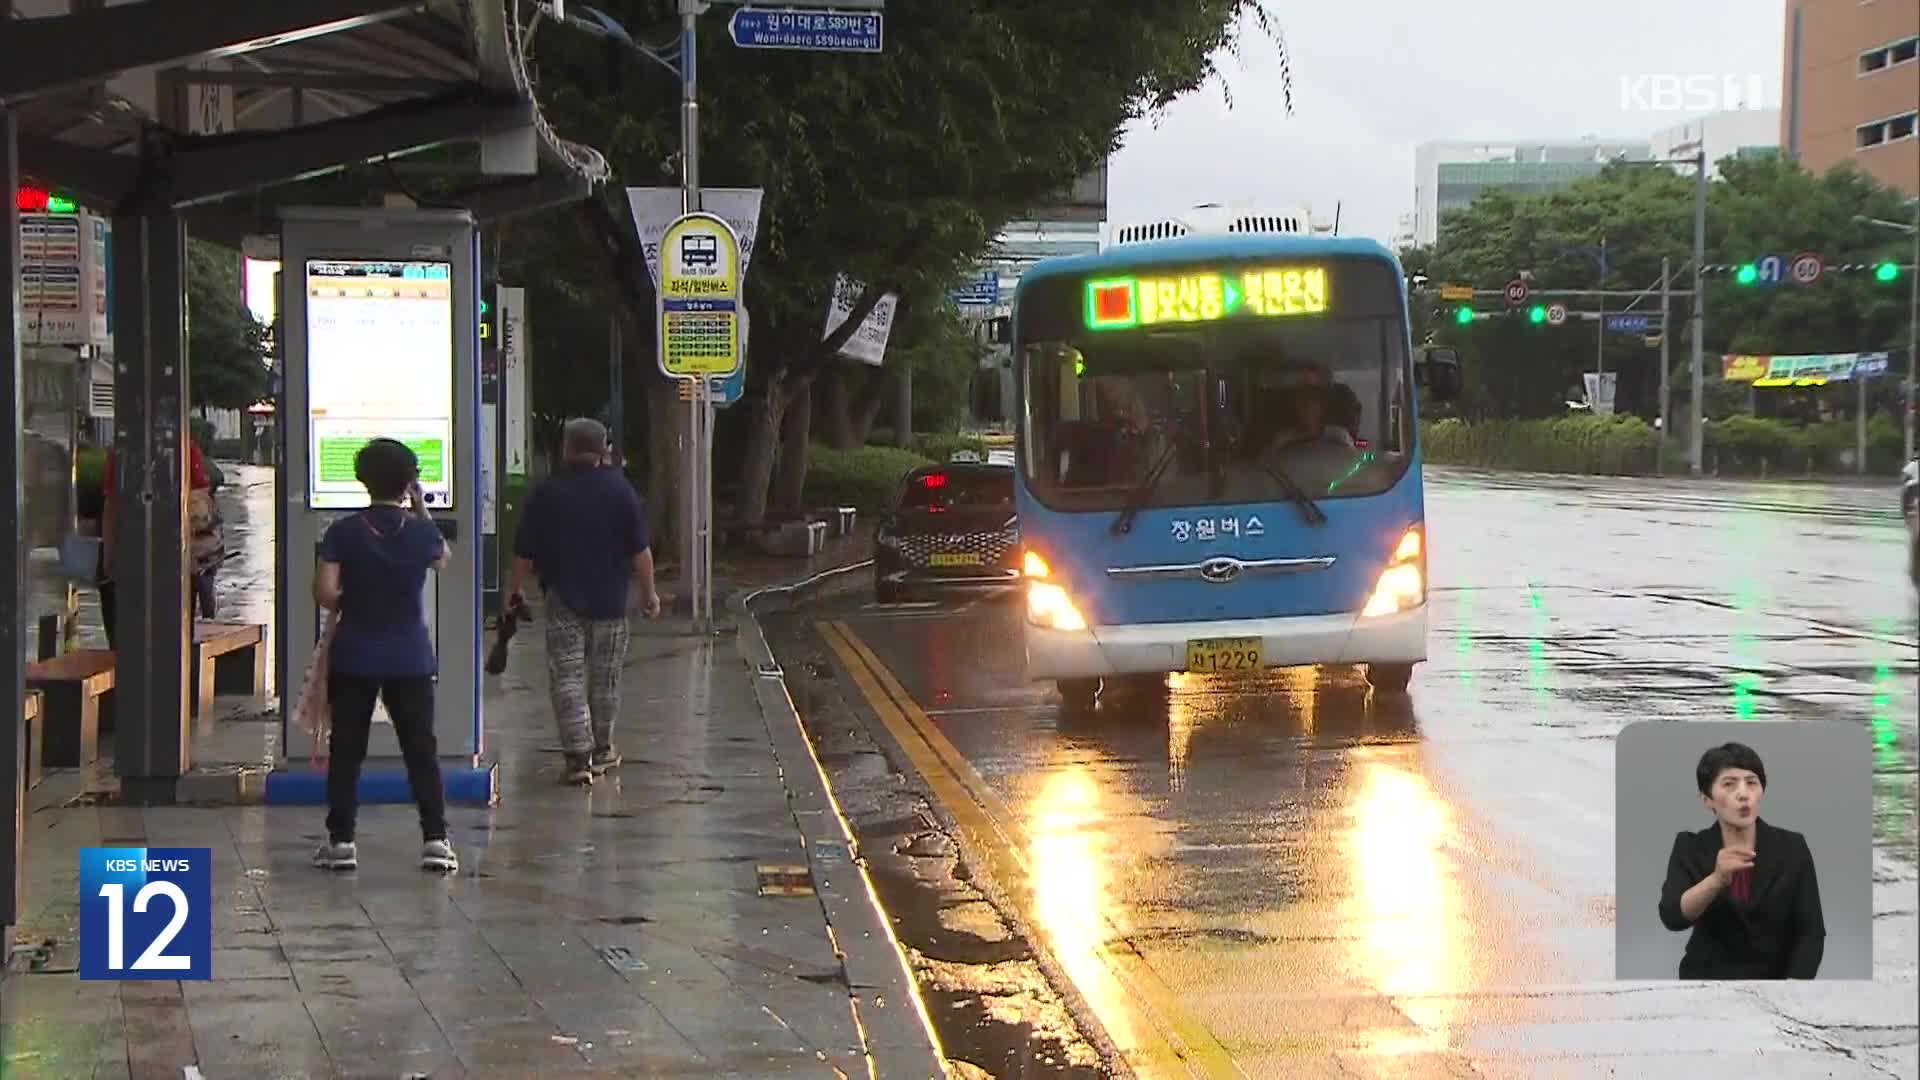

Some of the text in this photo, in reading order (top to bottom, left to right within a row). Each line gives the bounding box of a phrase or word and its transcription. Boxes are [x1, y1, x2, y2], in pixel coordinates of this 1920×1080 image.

[767, 13, 877, 35] 원이대로589번길
[1798, 262, 1817, 278] 60
[1510, 286, 1525, 299] 60
[1550, 307, 1565, 321] 60
